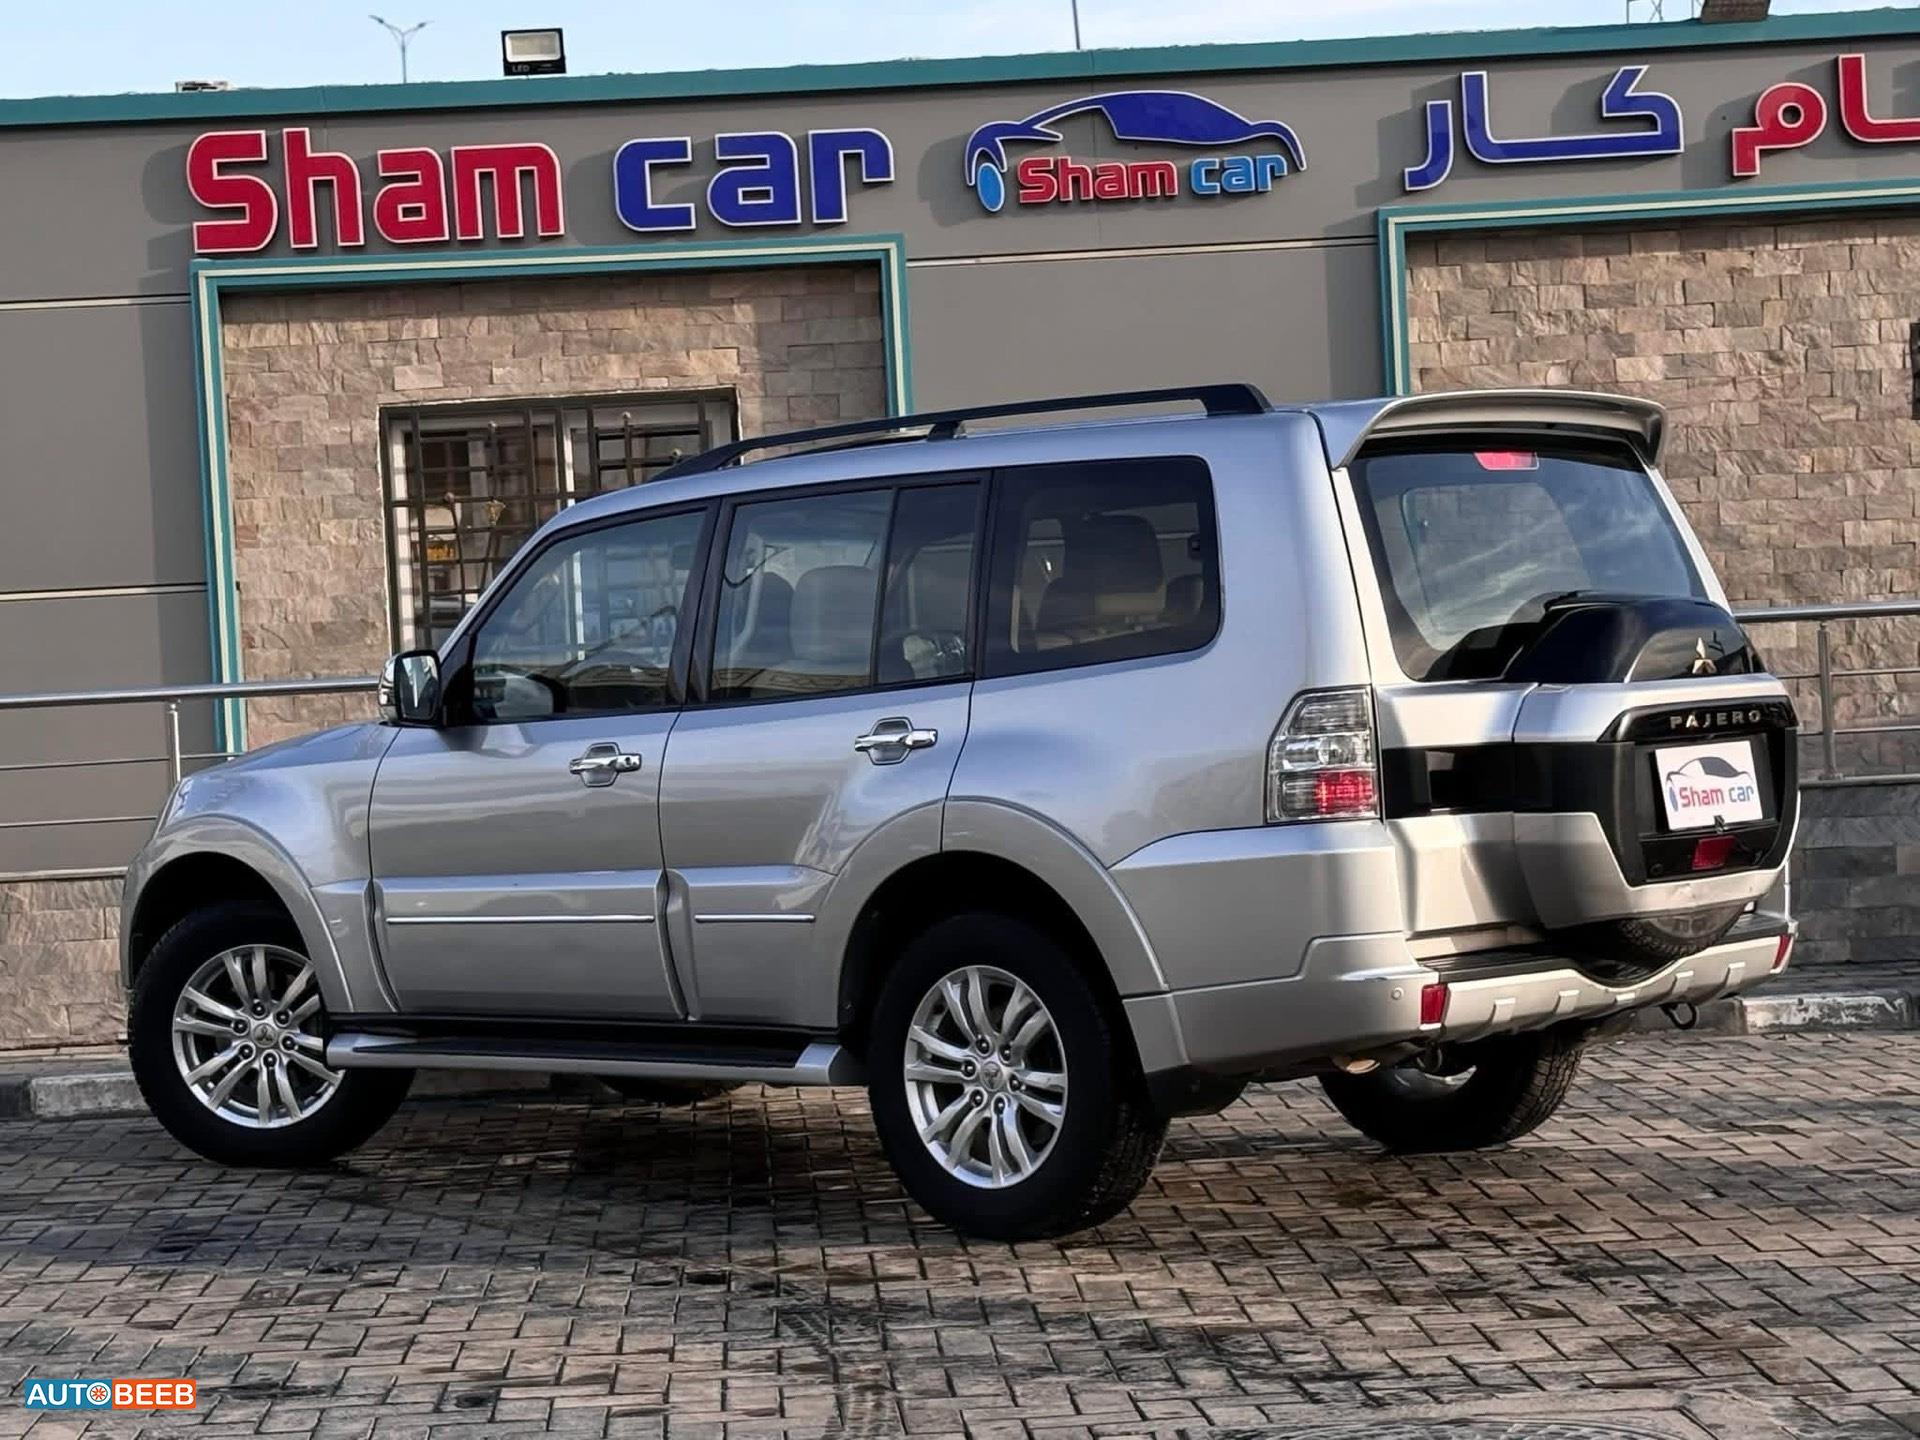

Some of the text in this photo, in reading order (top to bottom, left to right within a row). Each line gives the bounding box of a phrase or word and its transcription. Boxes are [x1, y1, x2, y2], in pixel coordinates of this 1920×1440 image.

[511, 64, 530, 73] LED
[1404, 53, 1920, 191] ام كار
[187, 128, 895, 253] Sham car
[1017, 154, 1288, 204] Sham car
[1670, 710, 1762, 730] PAJERO
[1679, 784, 1755, 809] Sham car
